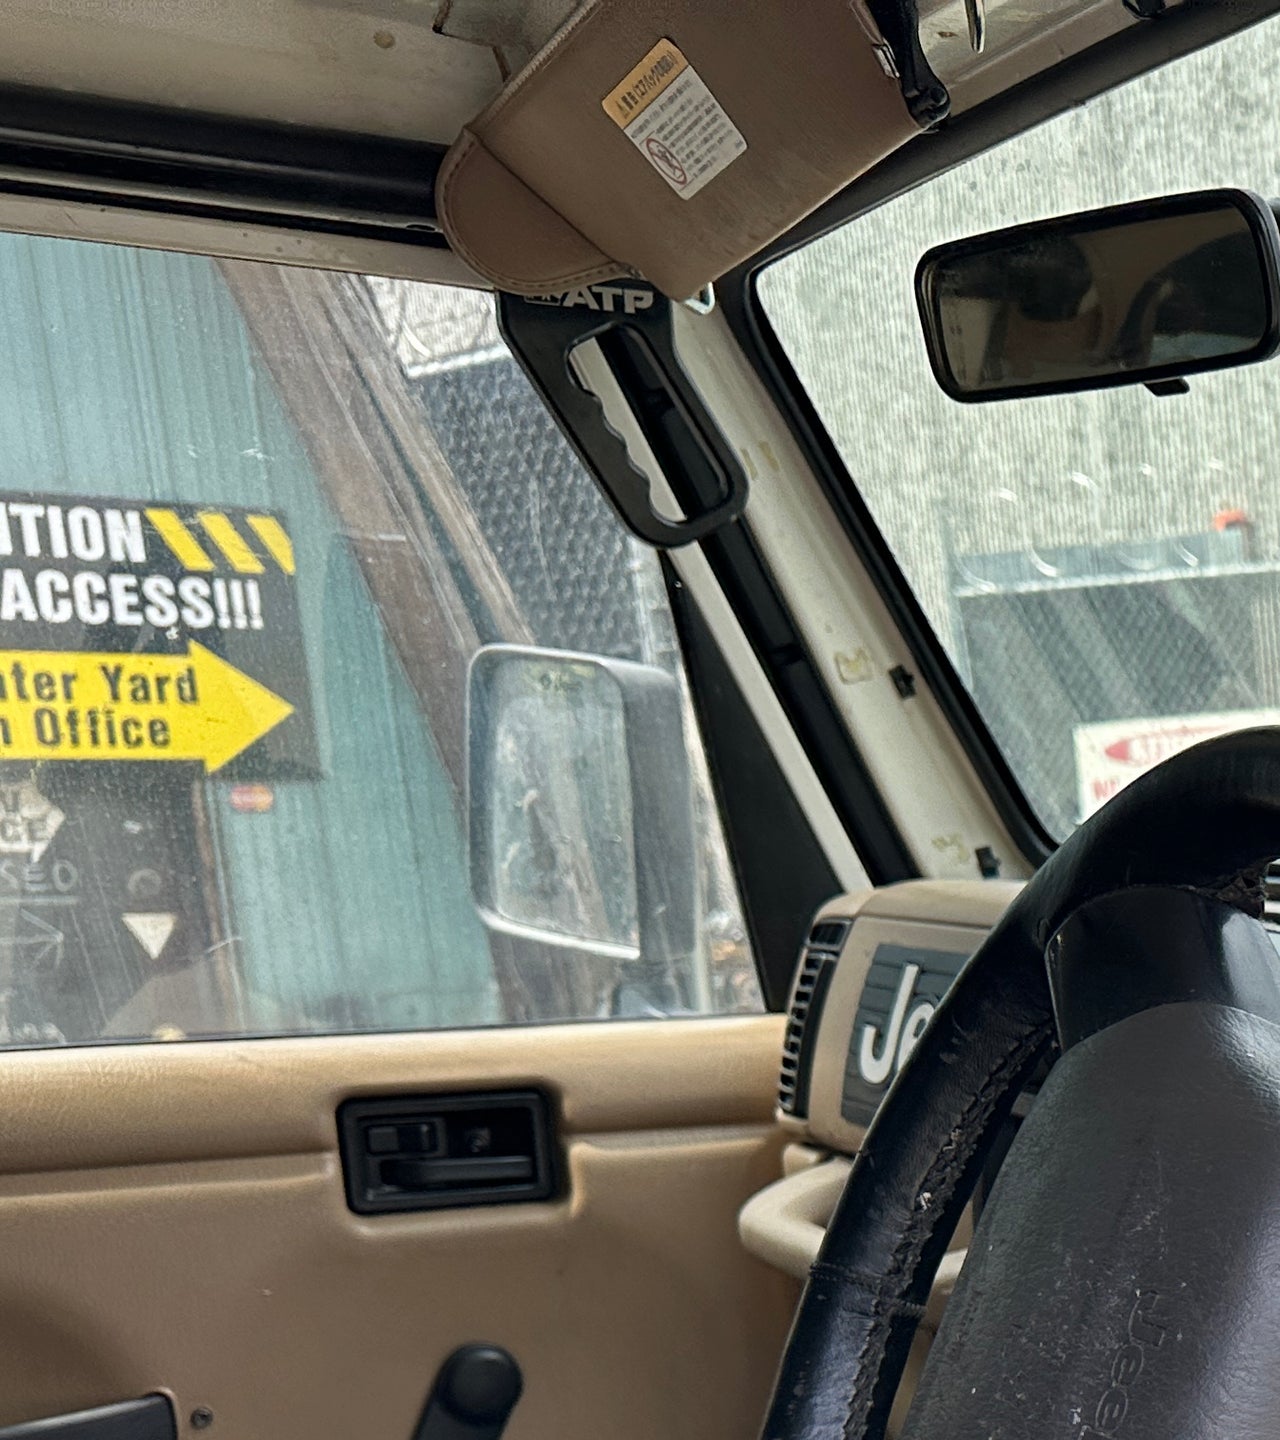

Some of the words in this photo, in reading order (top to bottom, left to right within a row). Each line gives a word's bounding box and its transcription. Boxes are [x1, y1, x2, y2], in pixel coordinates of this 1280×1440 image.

[0, 568, 264, 630] ACCESS!!!
[0, 661, 77, 702] ter
[100, 664, 200, 705] Yard
[34, 707, 171, 748] Office
